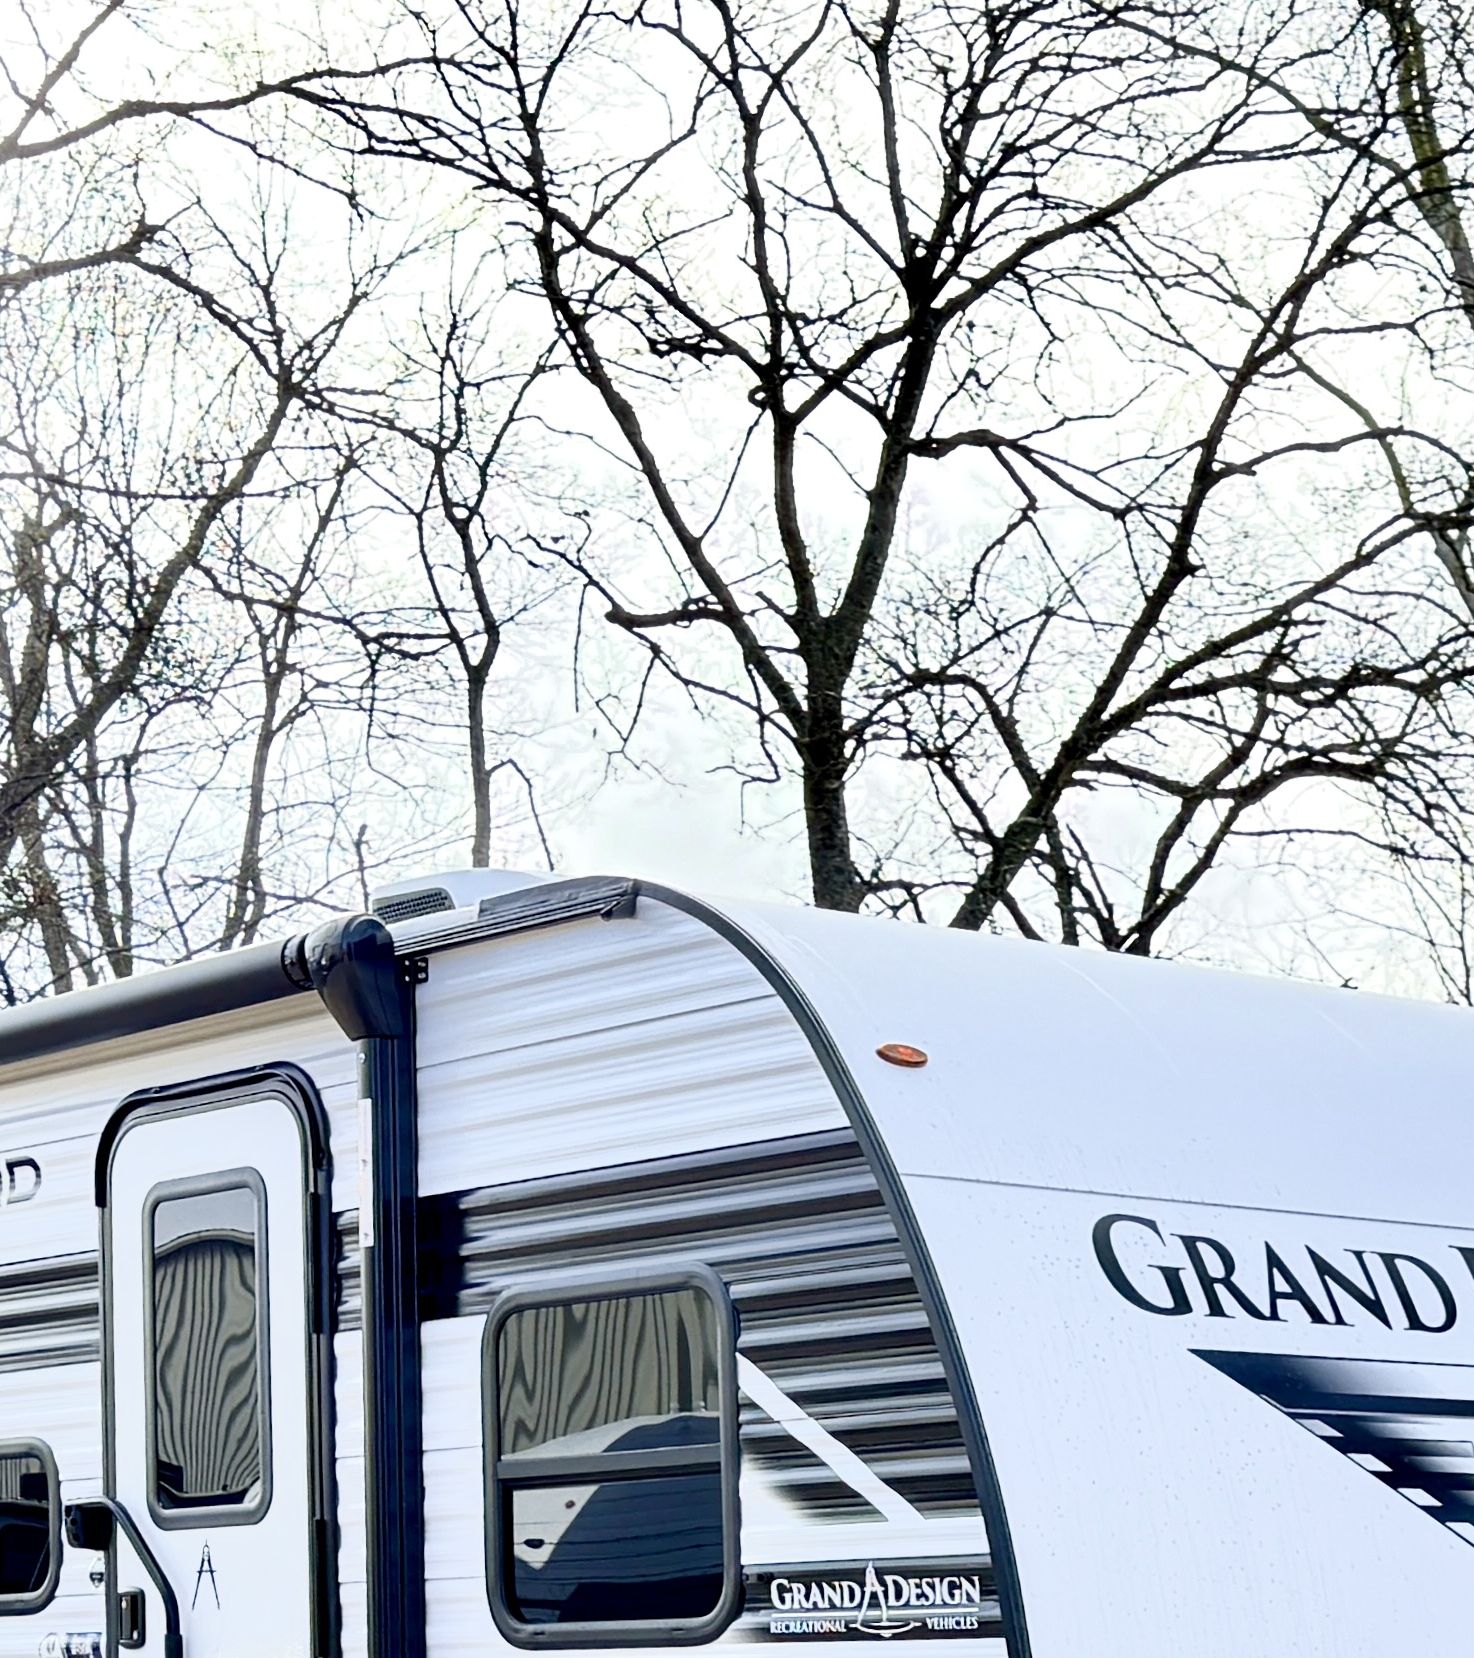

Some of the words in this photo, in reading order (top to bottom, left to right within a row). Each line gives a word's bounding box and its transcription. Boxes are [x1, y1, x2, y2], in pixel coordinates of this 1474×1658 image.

[1091, 1213, 1458, 1333] GRAND
[770, 1578, 863, 1610] GRAND
[883, 1574, 981, 1607] DESIGN
[769, 1619, 847, 1635] RECREATIONAL
[925, 1616, 979, 1631] VEHICLES
